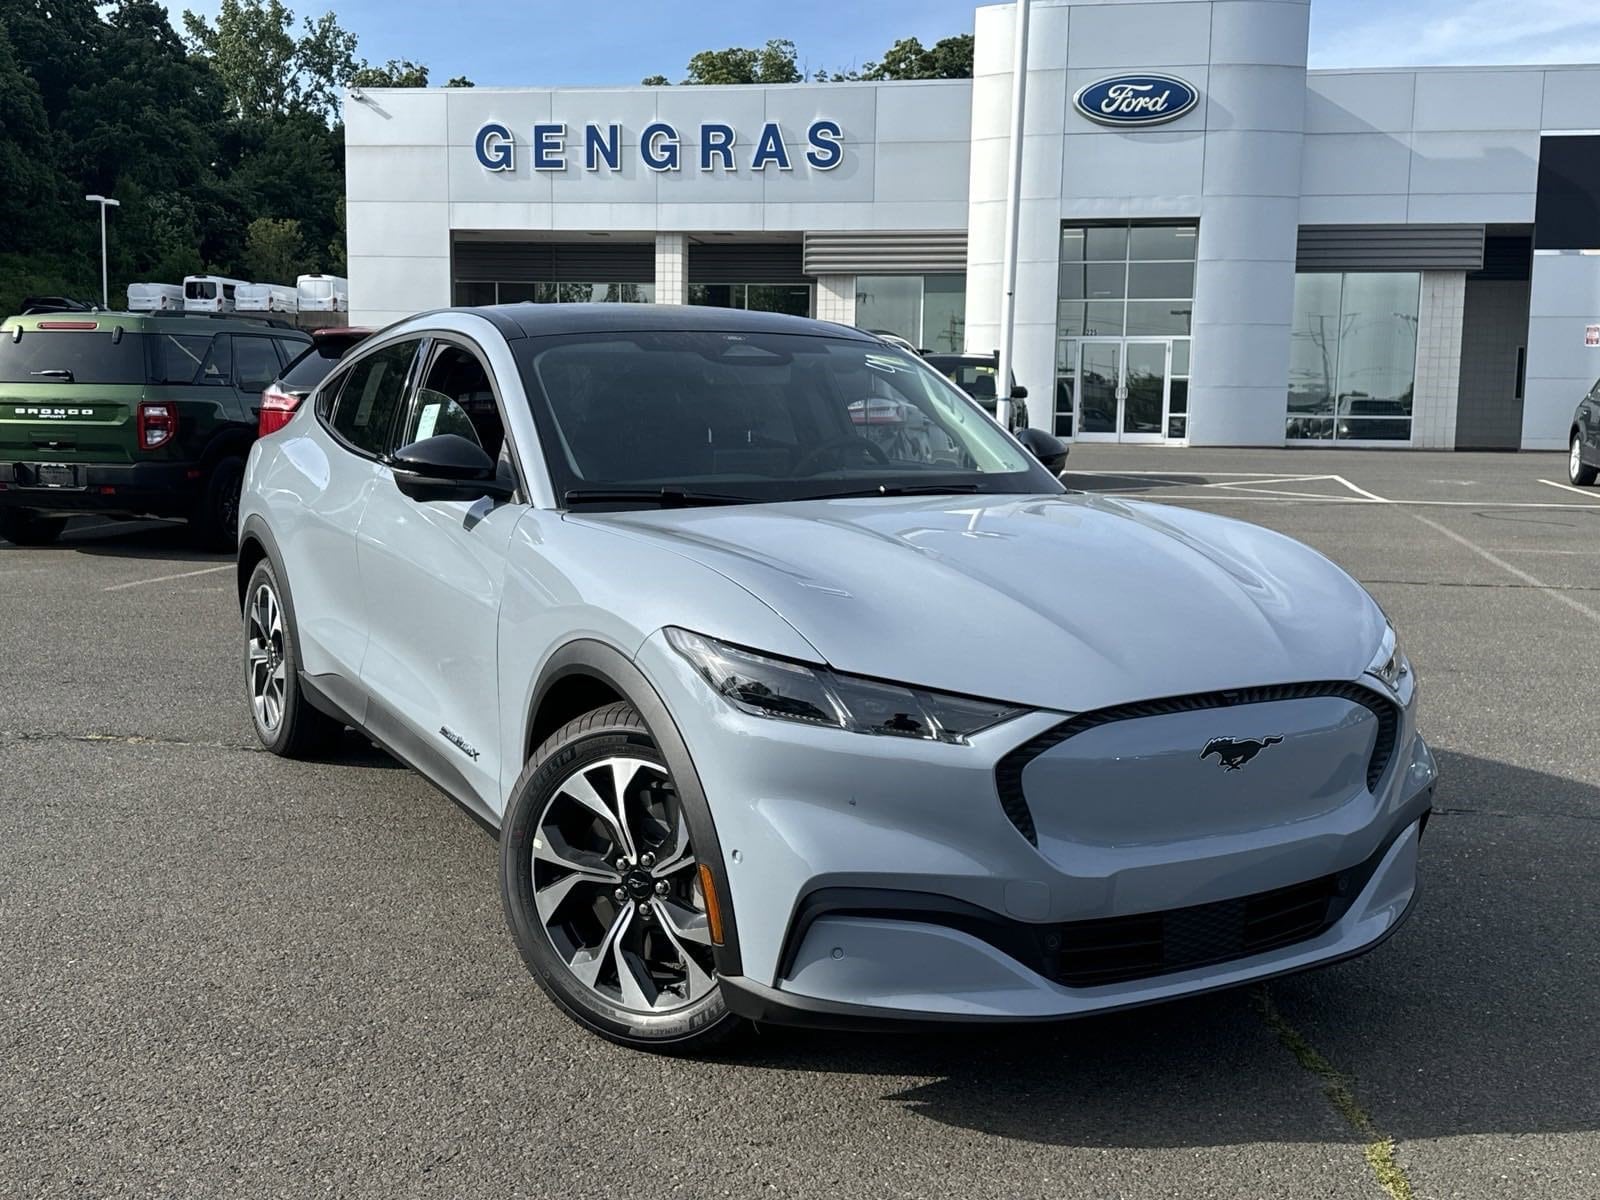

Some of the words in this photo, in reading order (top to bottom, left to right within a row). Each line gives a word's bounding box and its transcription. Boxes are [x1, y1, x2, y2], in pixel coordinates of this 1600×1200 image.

[1101, 84, 1170, 113] Ford
[475, 120, 843, 171] GENGRAS
[15, 407, 93, 415] BRONCO
